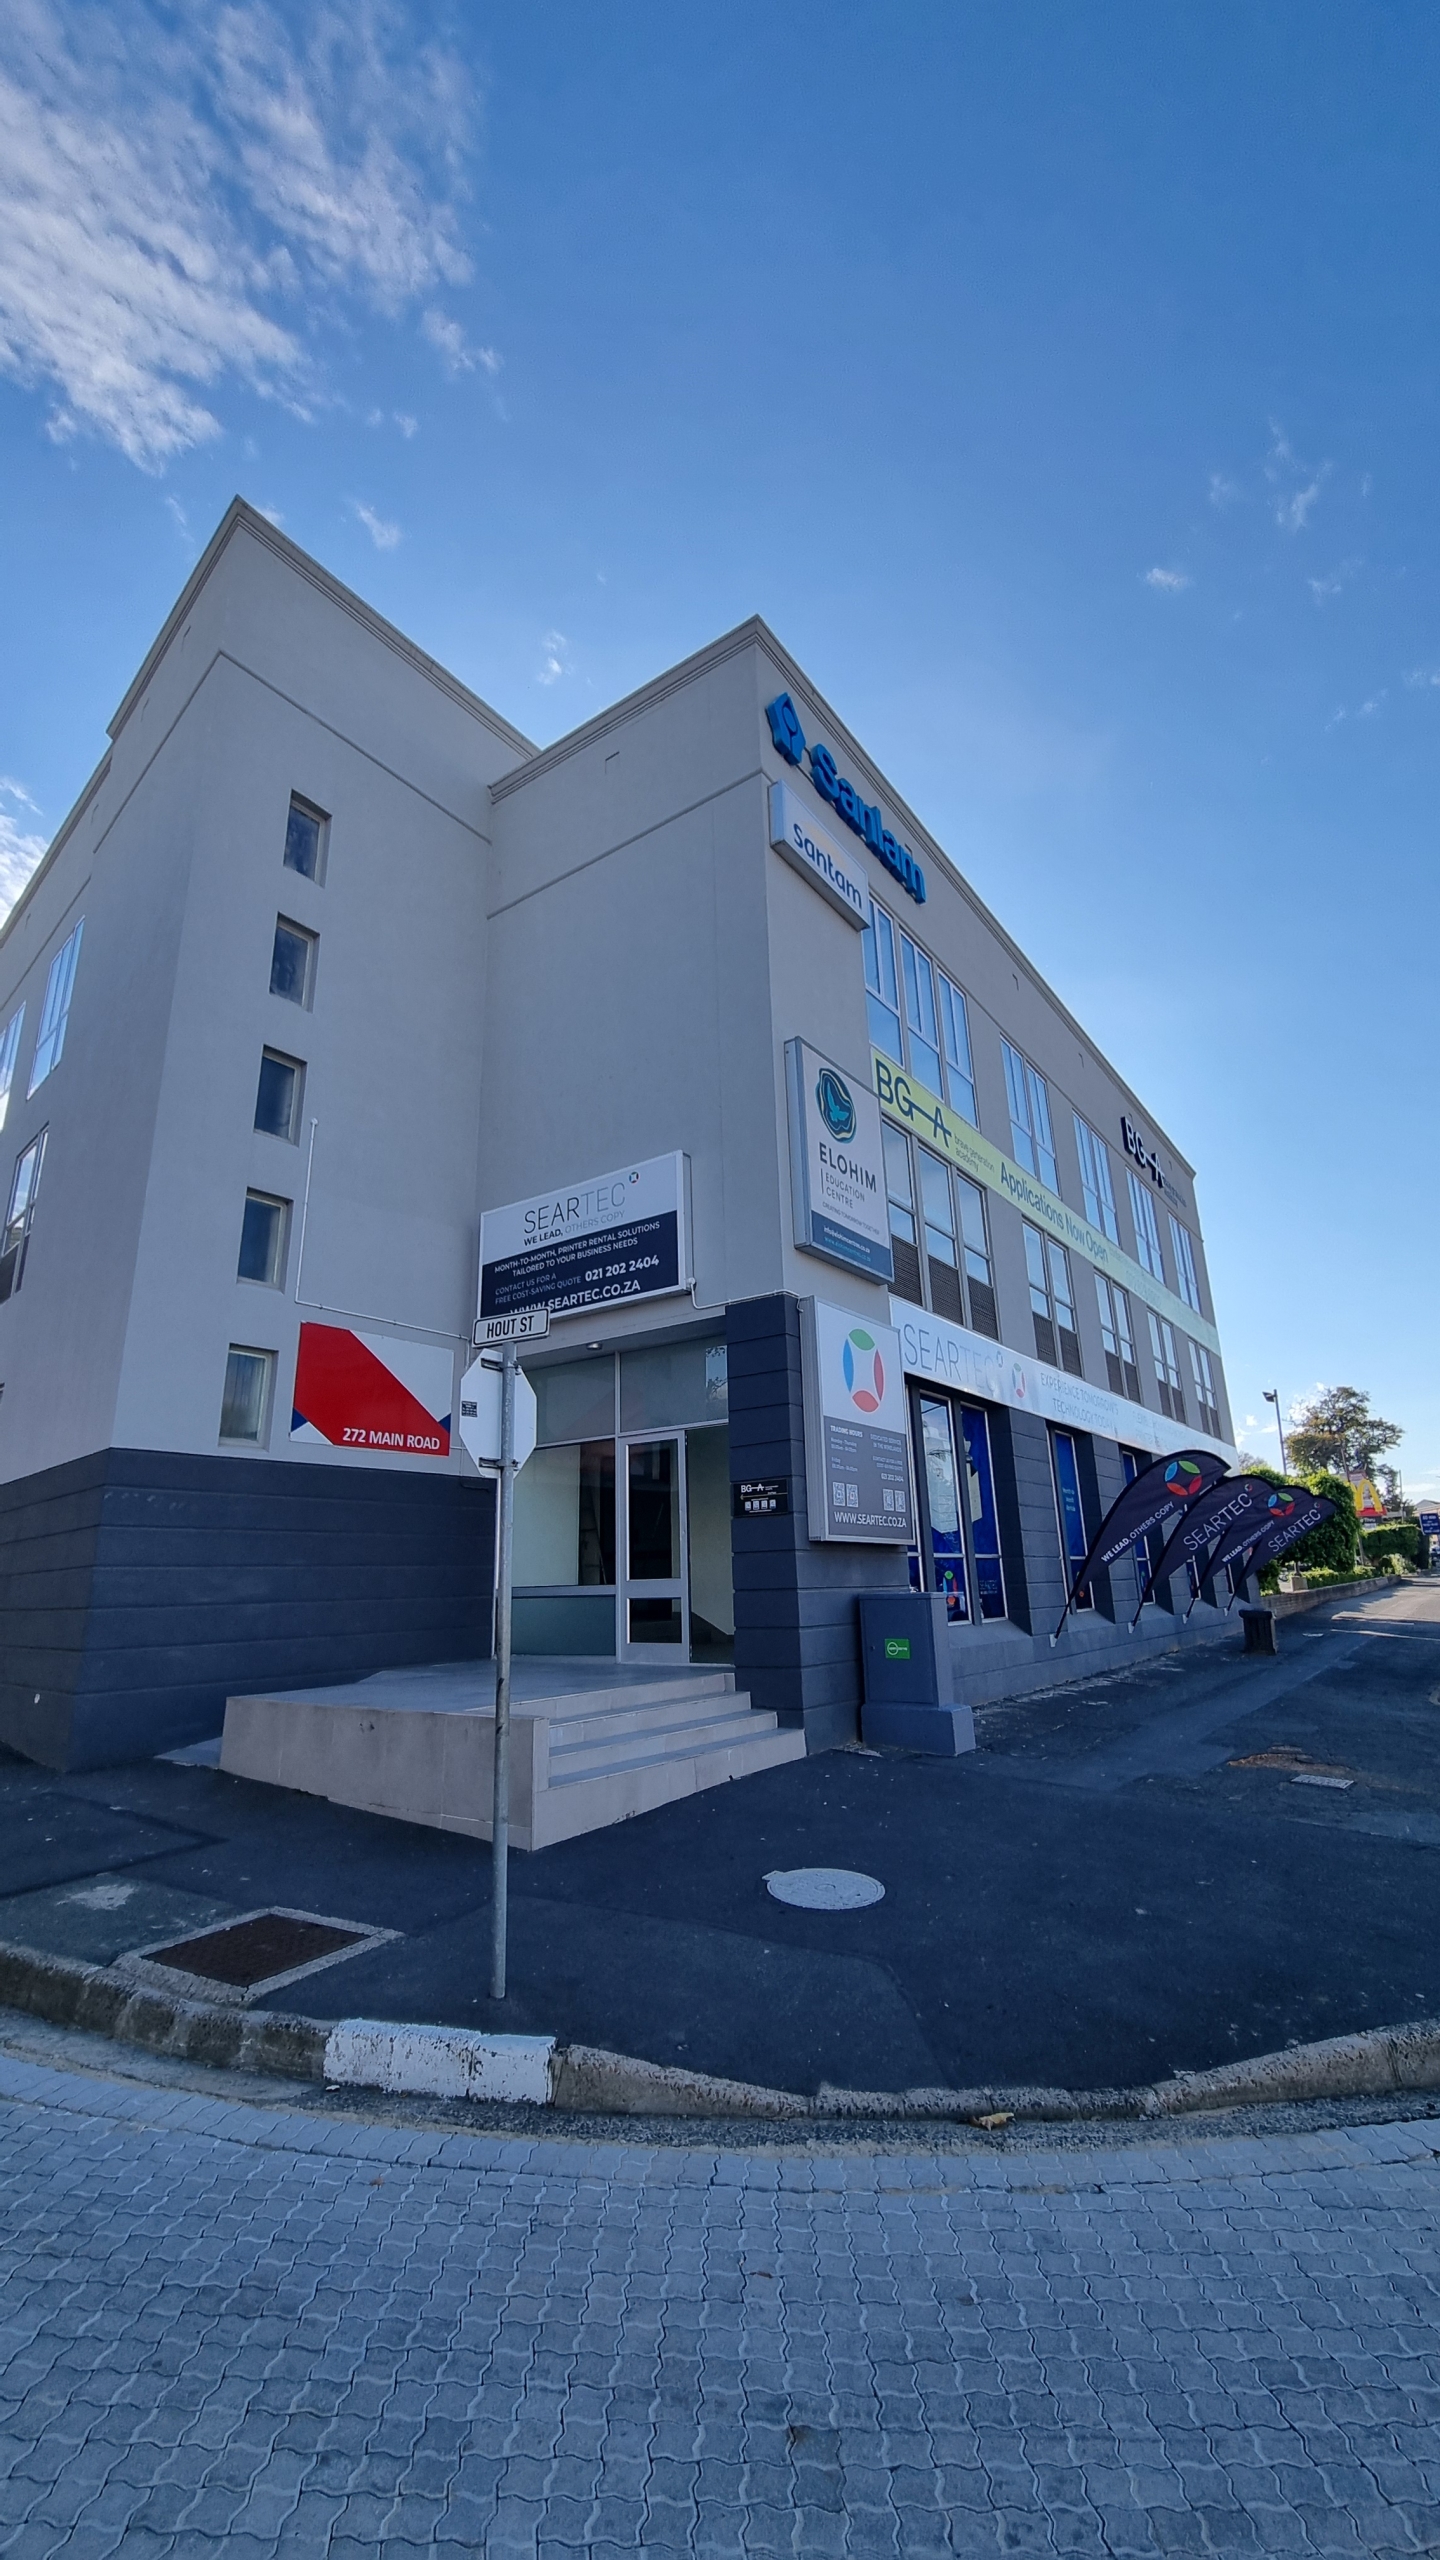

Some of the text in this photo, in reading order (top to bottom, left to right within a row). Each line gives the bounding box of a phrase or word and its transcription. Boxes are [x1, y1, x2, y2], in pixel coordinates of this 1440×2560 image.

[811, 744, 926, 904] Sanlam
[793, 823, 862, 909] Santam
[819, 1142, 877, 1193] ELOHIM
[826, 1172, 865, 1202] EDUCATION
[826, 1187, 853, 1209] CENTRE
[524, 1182, 625, 1234] SEARTEC
[1001, 1161, 1108, 1263] Applications Now Open
[524, 1210, 625, 1246] WE LEAD, OTHERS COPY
[558, 1241, 587, 1254] PRINTER
[589, 1233, 616, 1246] RENTAL
[618, 1221, 660, 1239] SOLUTIONS
[513, 1237, 638, 1277] TAILORED TO YOUR BUSINESS NEEDS
[585, 1255, 659, 1281] 021 202 2404
[495, 1281, 525, 1295] CONTACT
[526, 1278, 535, 1287] US
[537, 1275, 550, 1284] FOR
[495, 1276, 581, 1305] FREE COST-SAVING QUOTE
[510, 1280, 640, 1313] WWSEARTEC.CO.ZA
[486, 1315, 535, 1338] HOUT ST
[903, 1323, 995, 1394] SEARTEC
[343, 1428, 440, 1450] 272 MAIN ROAD
[834, 1511, 907, 1528] WWW.SEARTEC.CO.ZA
[1101, 1501, 1174, 1562] WE LEAD, OTHERS COPY
[1184, 1493, 1252, 1551] SEARTEC
[1268, 1509, 1321, 1552] SEARTEC
[1222, 1555, 1231, 1563] WE
[1243, 1531, 1261, 1547] OTHERS
[1261, 1520, 1275, 1533] COPY
